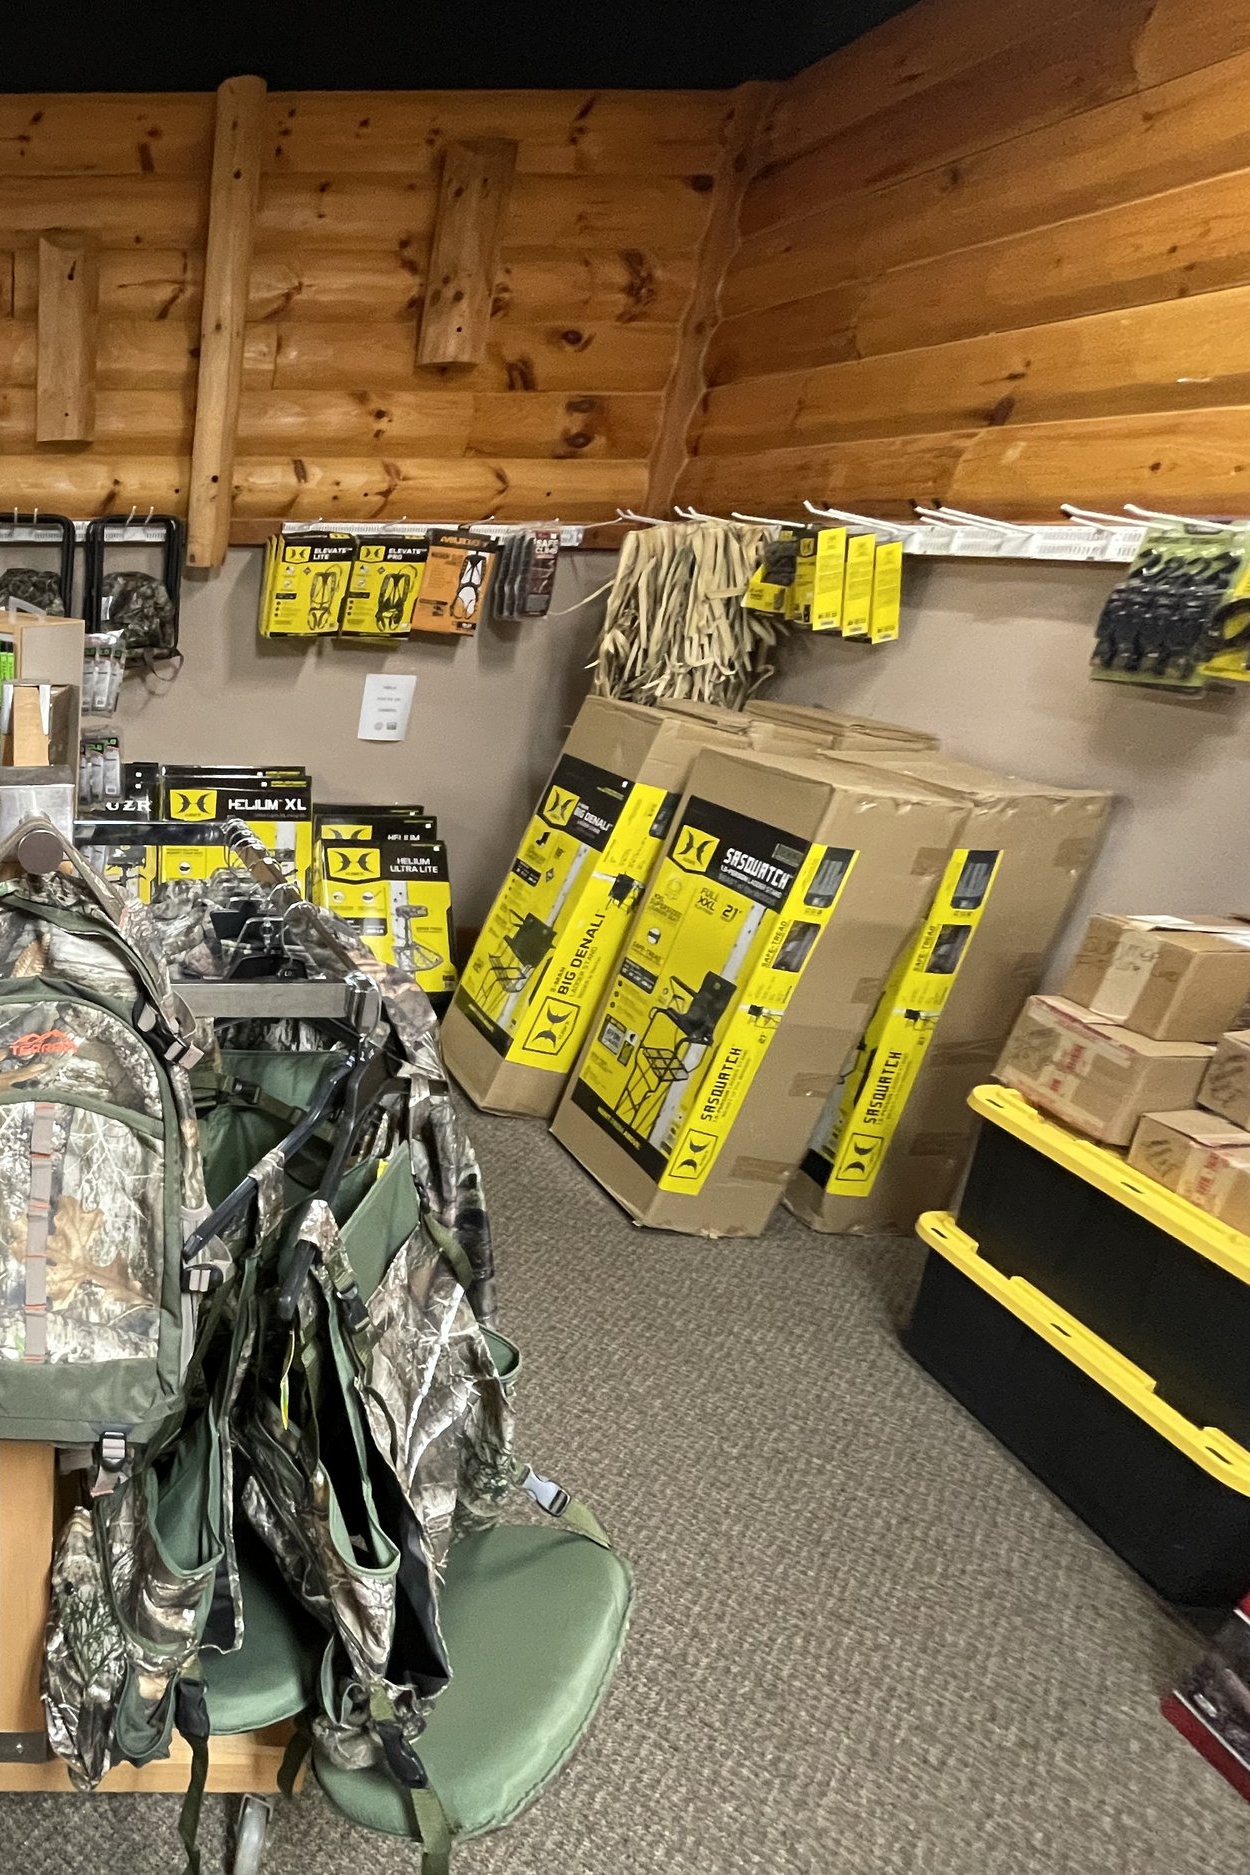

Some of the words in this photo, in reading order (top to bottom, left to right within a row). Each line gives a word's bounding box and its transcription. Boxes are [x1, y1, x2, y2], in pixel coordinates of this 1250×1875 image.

[228, 799, 278, 810] HELIUM
[284, 799, 307, 810] XL
[583, 812, 611, 832] DENALI
[390, 865, 419, 873] ULTRA
[397, 857, 431, 865] HELIUM
[723, 847, 789, 891] SASQUATCH
[697, 895, 716, 911] XXL
[557, 970, 575, 995] BIG
[570, 913, 606, 967] DENALI
[700, 1046, 743, 1122] SASQUATCH
[863, 1051, 902, 1125] SASQUATCH
